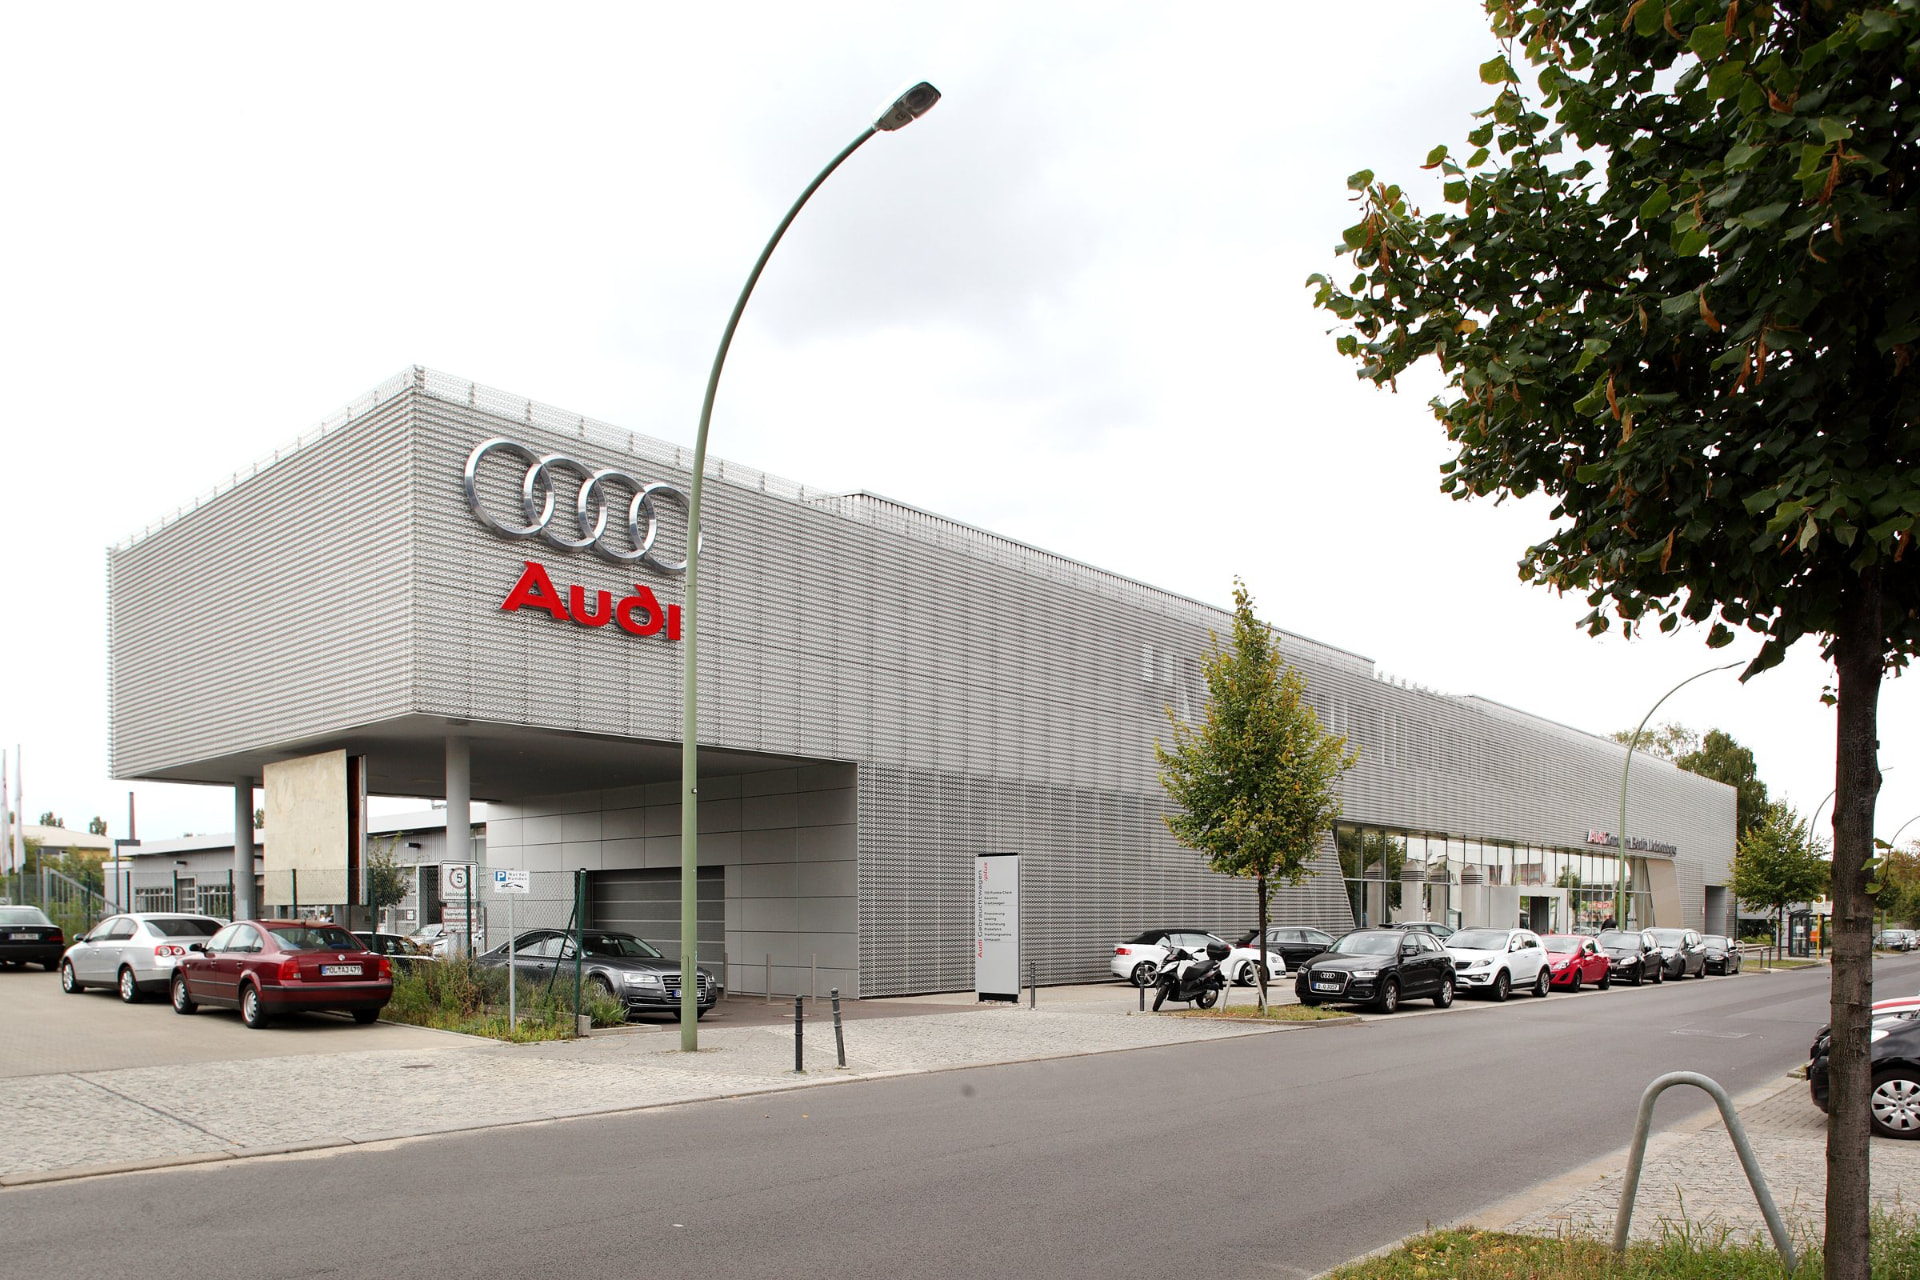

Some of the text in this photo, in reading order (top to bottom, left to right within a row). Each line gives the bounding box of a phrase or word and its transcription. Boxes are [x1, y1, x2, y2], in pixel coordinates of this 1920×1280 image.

[499, 560, 682, 641] Audi
[456, 873, 462, 883] 5
[498, 872, 506, 880] P
